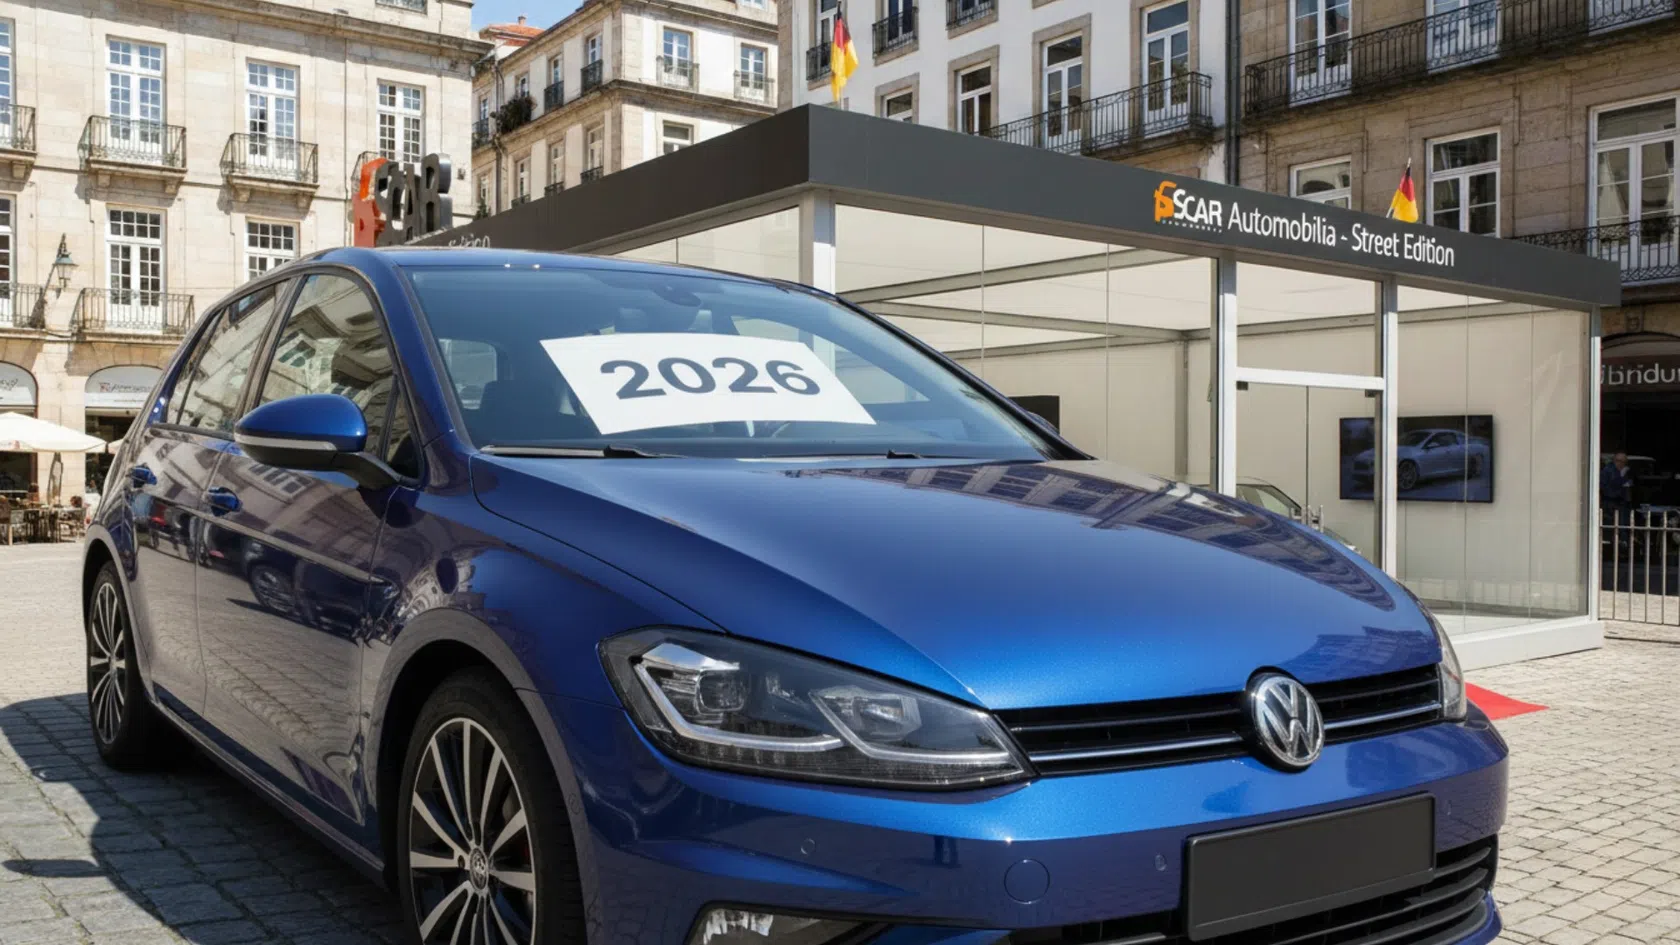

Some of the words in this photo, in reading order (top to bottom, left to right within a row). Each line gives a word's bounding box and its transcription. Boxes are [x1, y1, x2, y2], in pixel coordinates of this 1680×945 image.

[1227, 202, 1336, 247] Automobilia
[1351, 223, 1400, 258] Street
[1404, 233, 1455, 267] Edition
[600, 357, 821, 400] 2026
